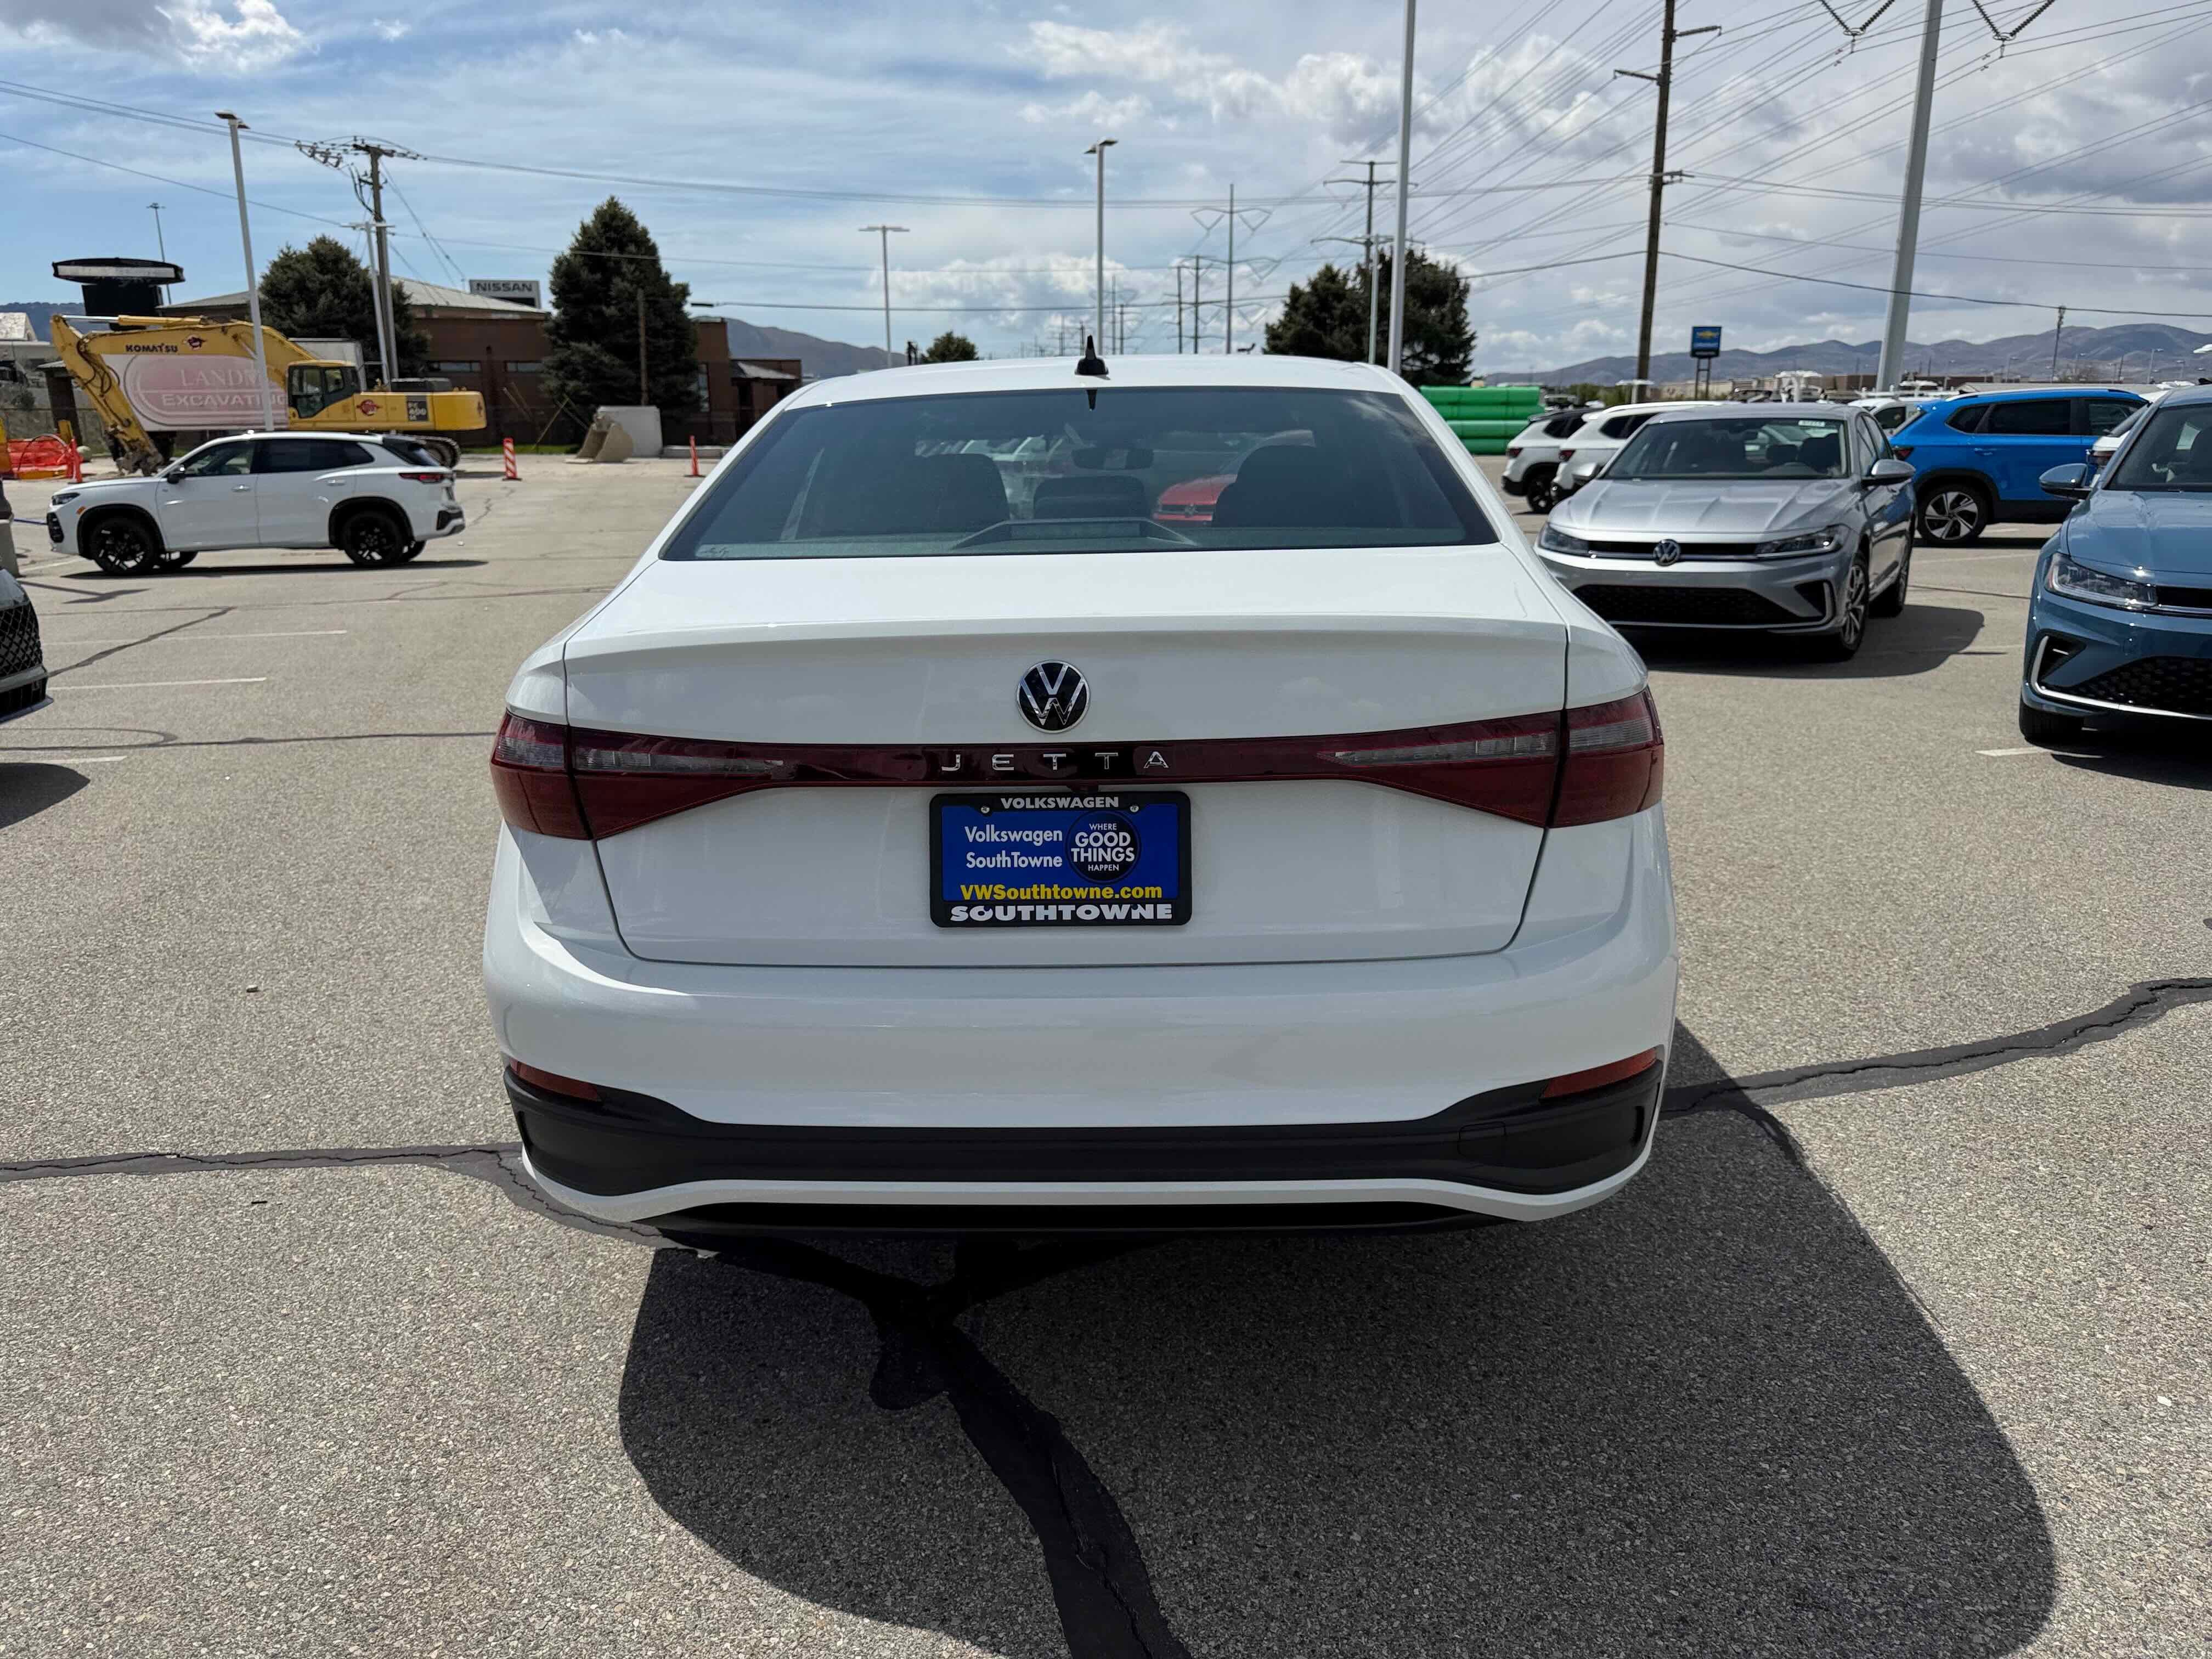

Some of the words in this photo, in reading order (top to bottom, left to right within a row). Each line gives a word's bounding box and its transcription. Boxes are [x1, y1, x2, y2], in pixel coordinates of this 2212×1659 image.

[476, 282, 532, 292] NISSAN
[125, 343, 178, 353] KOMATSU
[941, 751, 1169, 771] JETTA
[1000, 797, 1119, 809] VOLKSWAGEN
[964, 824, 1063, 847] Volkswagen
[1075, 832, 1131, 848] GOOD
[966, 850, 1063, 868] SouthTowne
[1071, 847, 1135, 863] THINGS
[1087, 864, 1120, 872] HAPPEN
[960, 884, 1163, 900] VWSouthtowne.com
[950, 904, 1172, 922] SOUTHTOWNE
